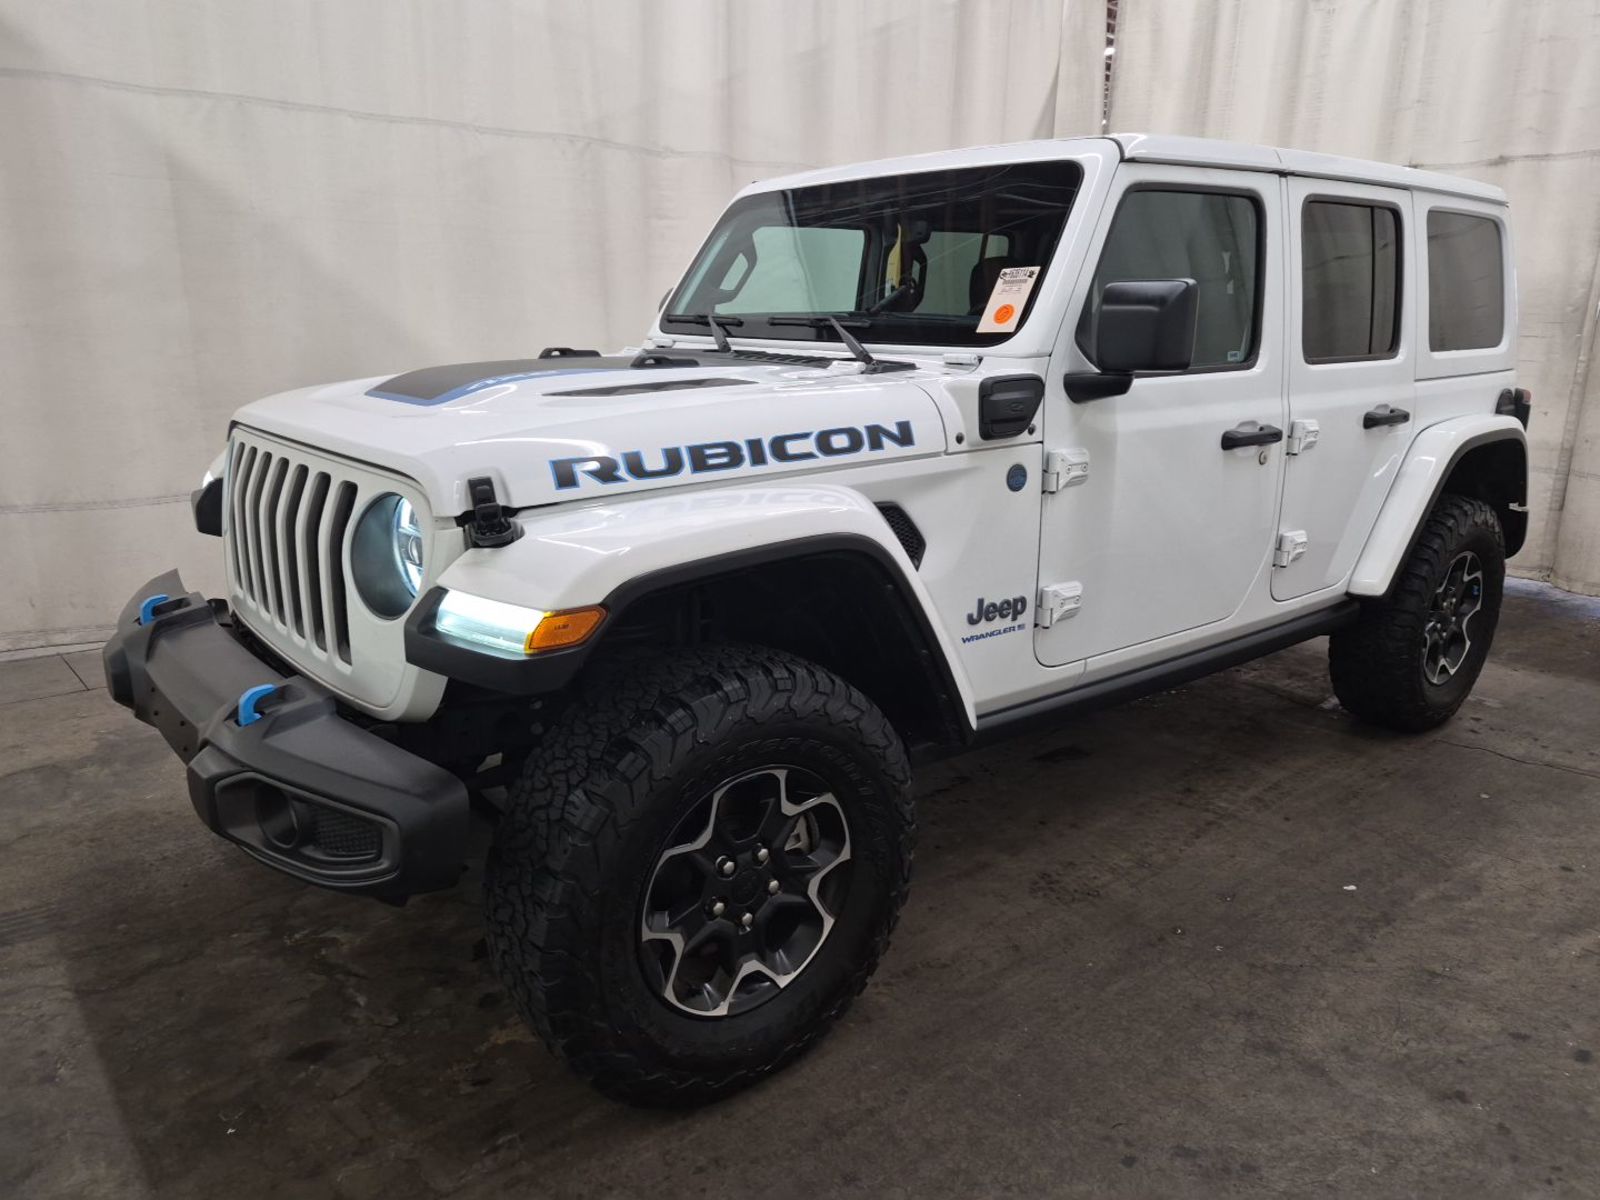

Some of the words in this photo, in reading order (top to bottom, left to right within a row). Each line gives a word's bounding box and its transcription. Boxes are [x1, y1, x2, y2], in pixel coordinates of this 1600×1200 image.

[549, 420, 915, 490] RUBICON
[967, 595, 1027, 625] Jeep
[961, 625, 1016, 644] WRANGLER
